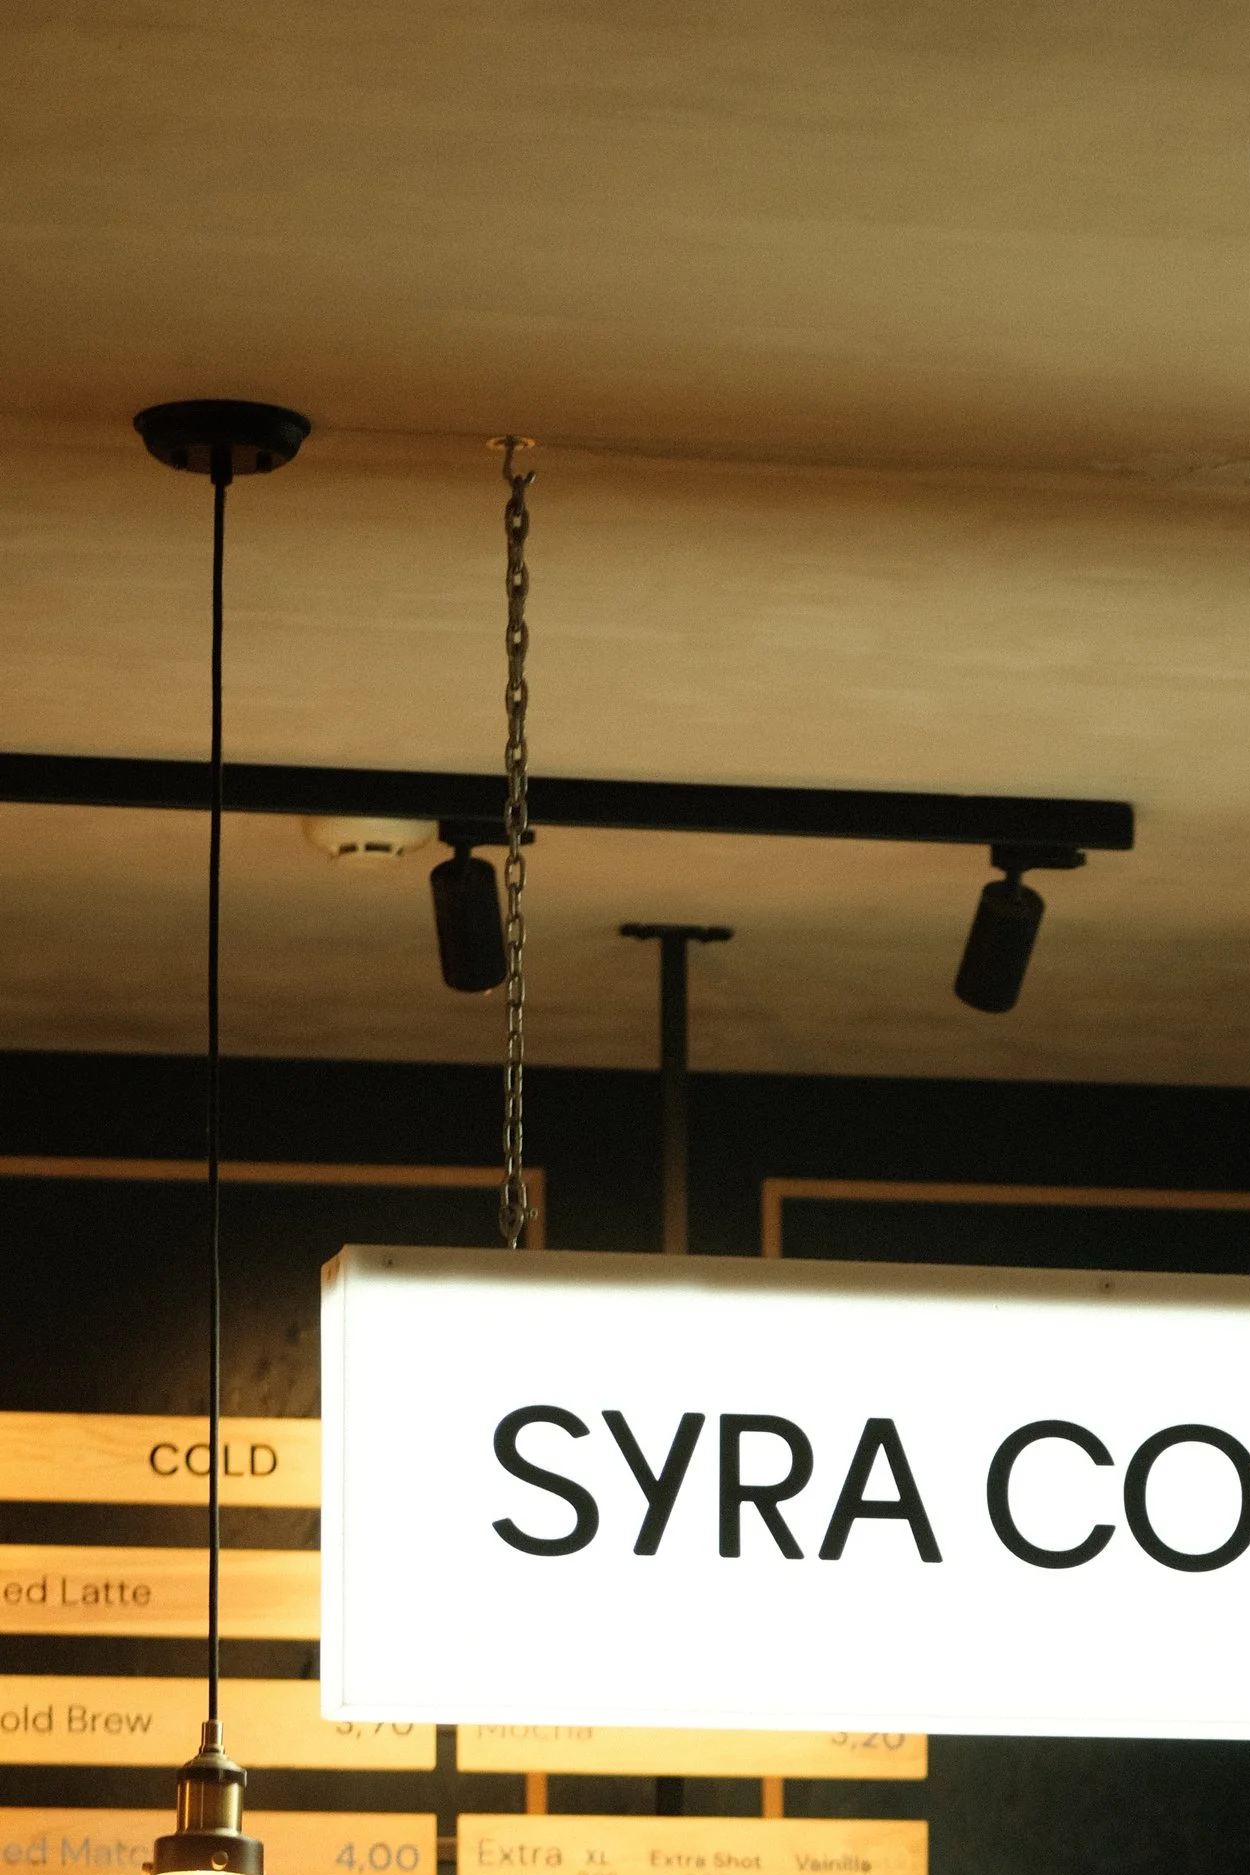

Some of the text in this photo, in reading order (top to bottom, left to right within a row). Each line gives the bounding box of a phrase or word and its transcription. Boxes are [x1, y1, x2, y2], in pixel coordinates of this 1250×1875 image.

[149, 1441, 279, 1478] COLD
[490, 1403, 943, 1563] SYRA
[3, 1575, 152, 1607] ed Latte
[0, 1704, 54, 1734] old
[67, 1704, 153, 1735] Brew
[334, 1842, 420, 1875] 4,00
[478, 1837, 564, 1867] Extra
[585, 1848, 609, 1866] XL
[650, 1849, 706, 1869] Extra
[713, 1851, 762, 1871] Shot
